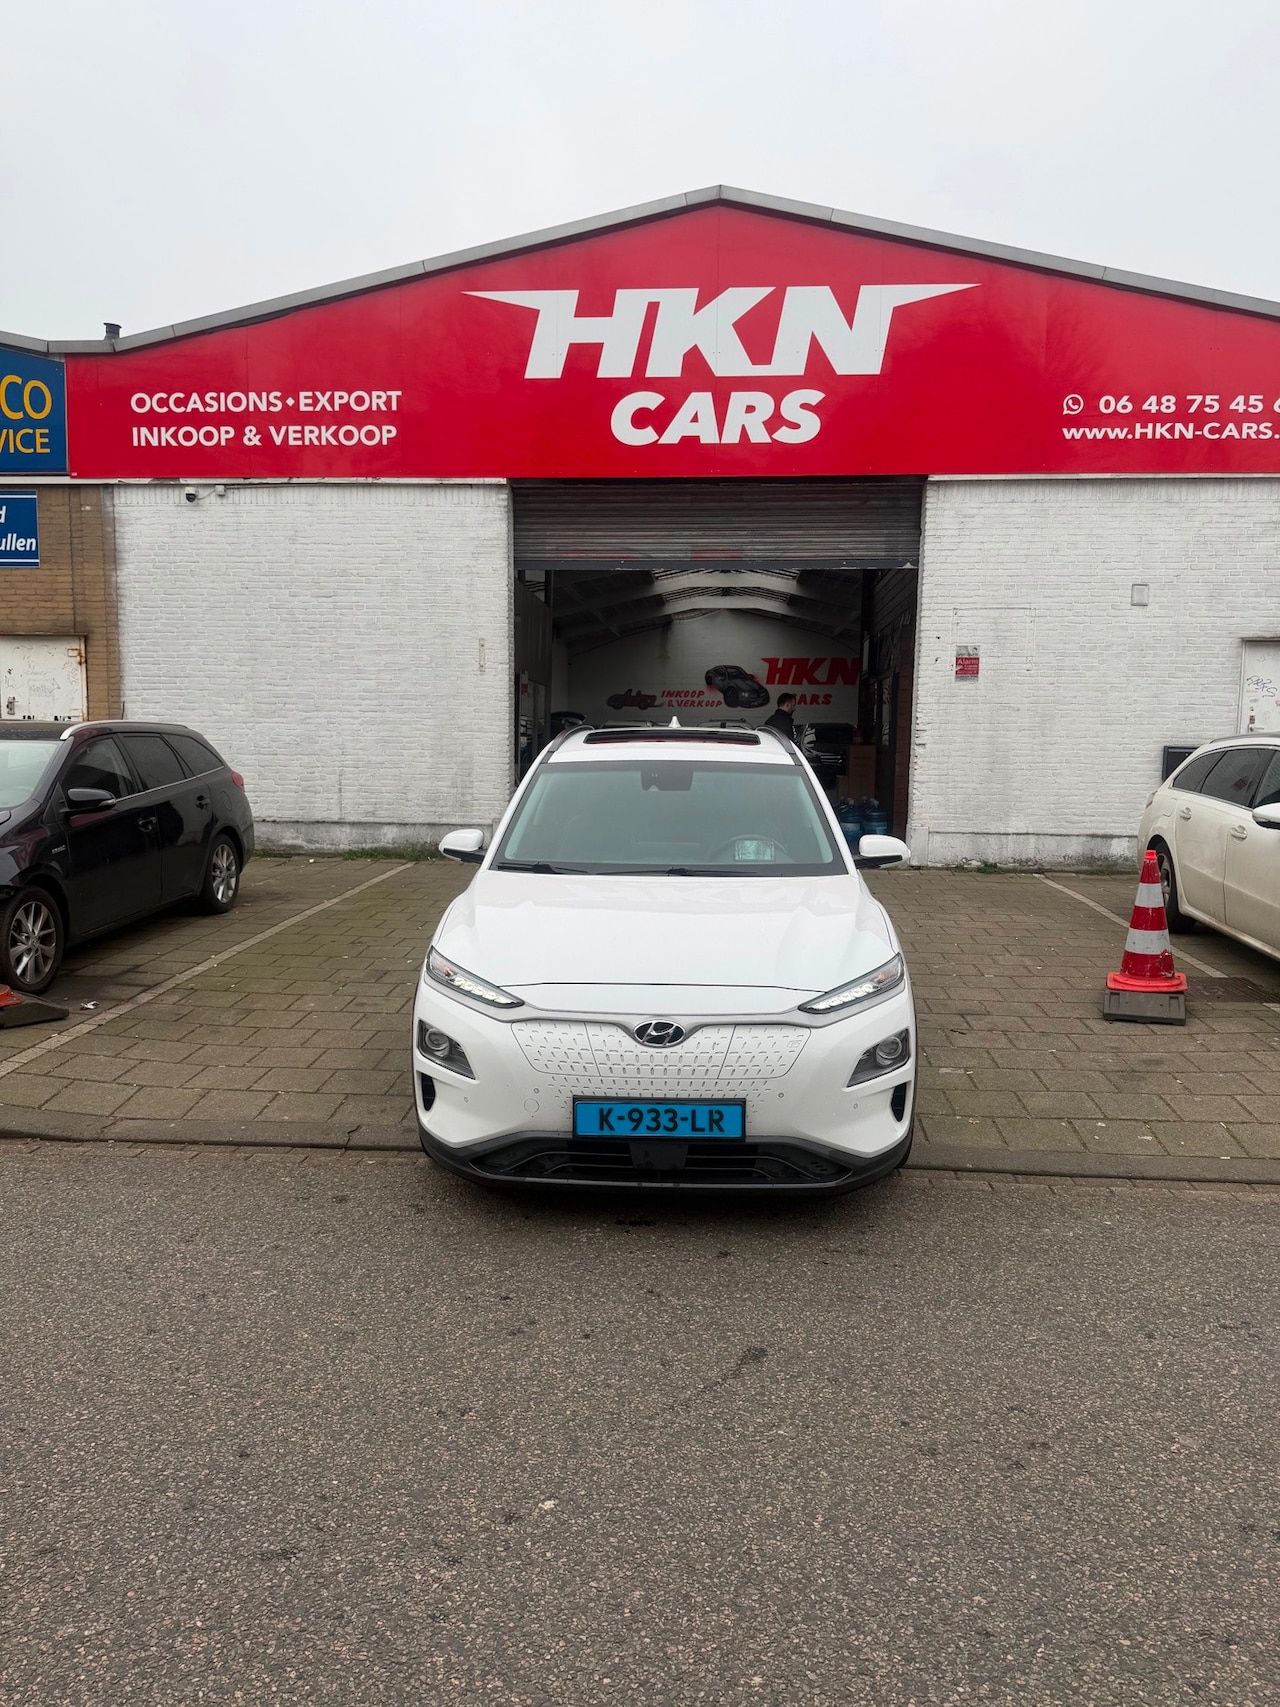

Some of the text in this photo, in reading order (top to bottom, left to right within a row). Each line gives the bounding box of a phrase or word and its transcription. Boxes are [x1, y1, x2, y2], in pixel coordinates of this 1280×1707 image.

[461, 283, 982, 379] HKN
[0, 374, 52, 420] CO
[131, 391, 402, 413] OCCASIONS EXPORT
[1099, 395, 1133, 414] 06
[1142, 395, 1177, 414] 48
[1186, 395, 1220, 414] 75
[1229, 395, 1264, 413] 45
[610, 389, 826, 446] CARS
[132, 425, 398, 447] INKOOP & VERKOOP
[761, 657, 862, 686] HKN
[676, 700, 723, 708] VERKOOP
[599, 1107, 725, 1133] K-933-LR
